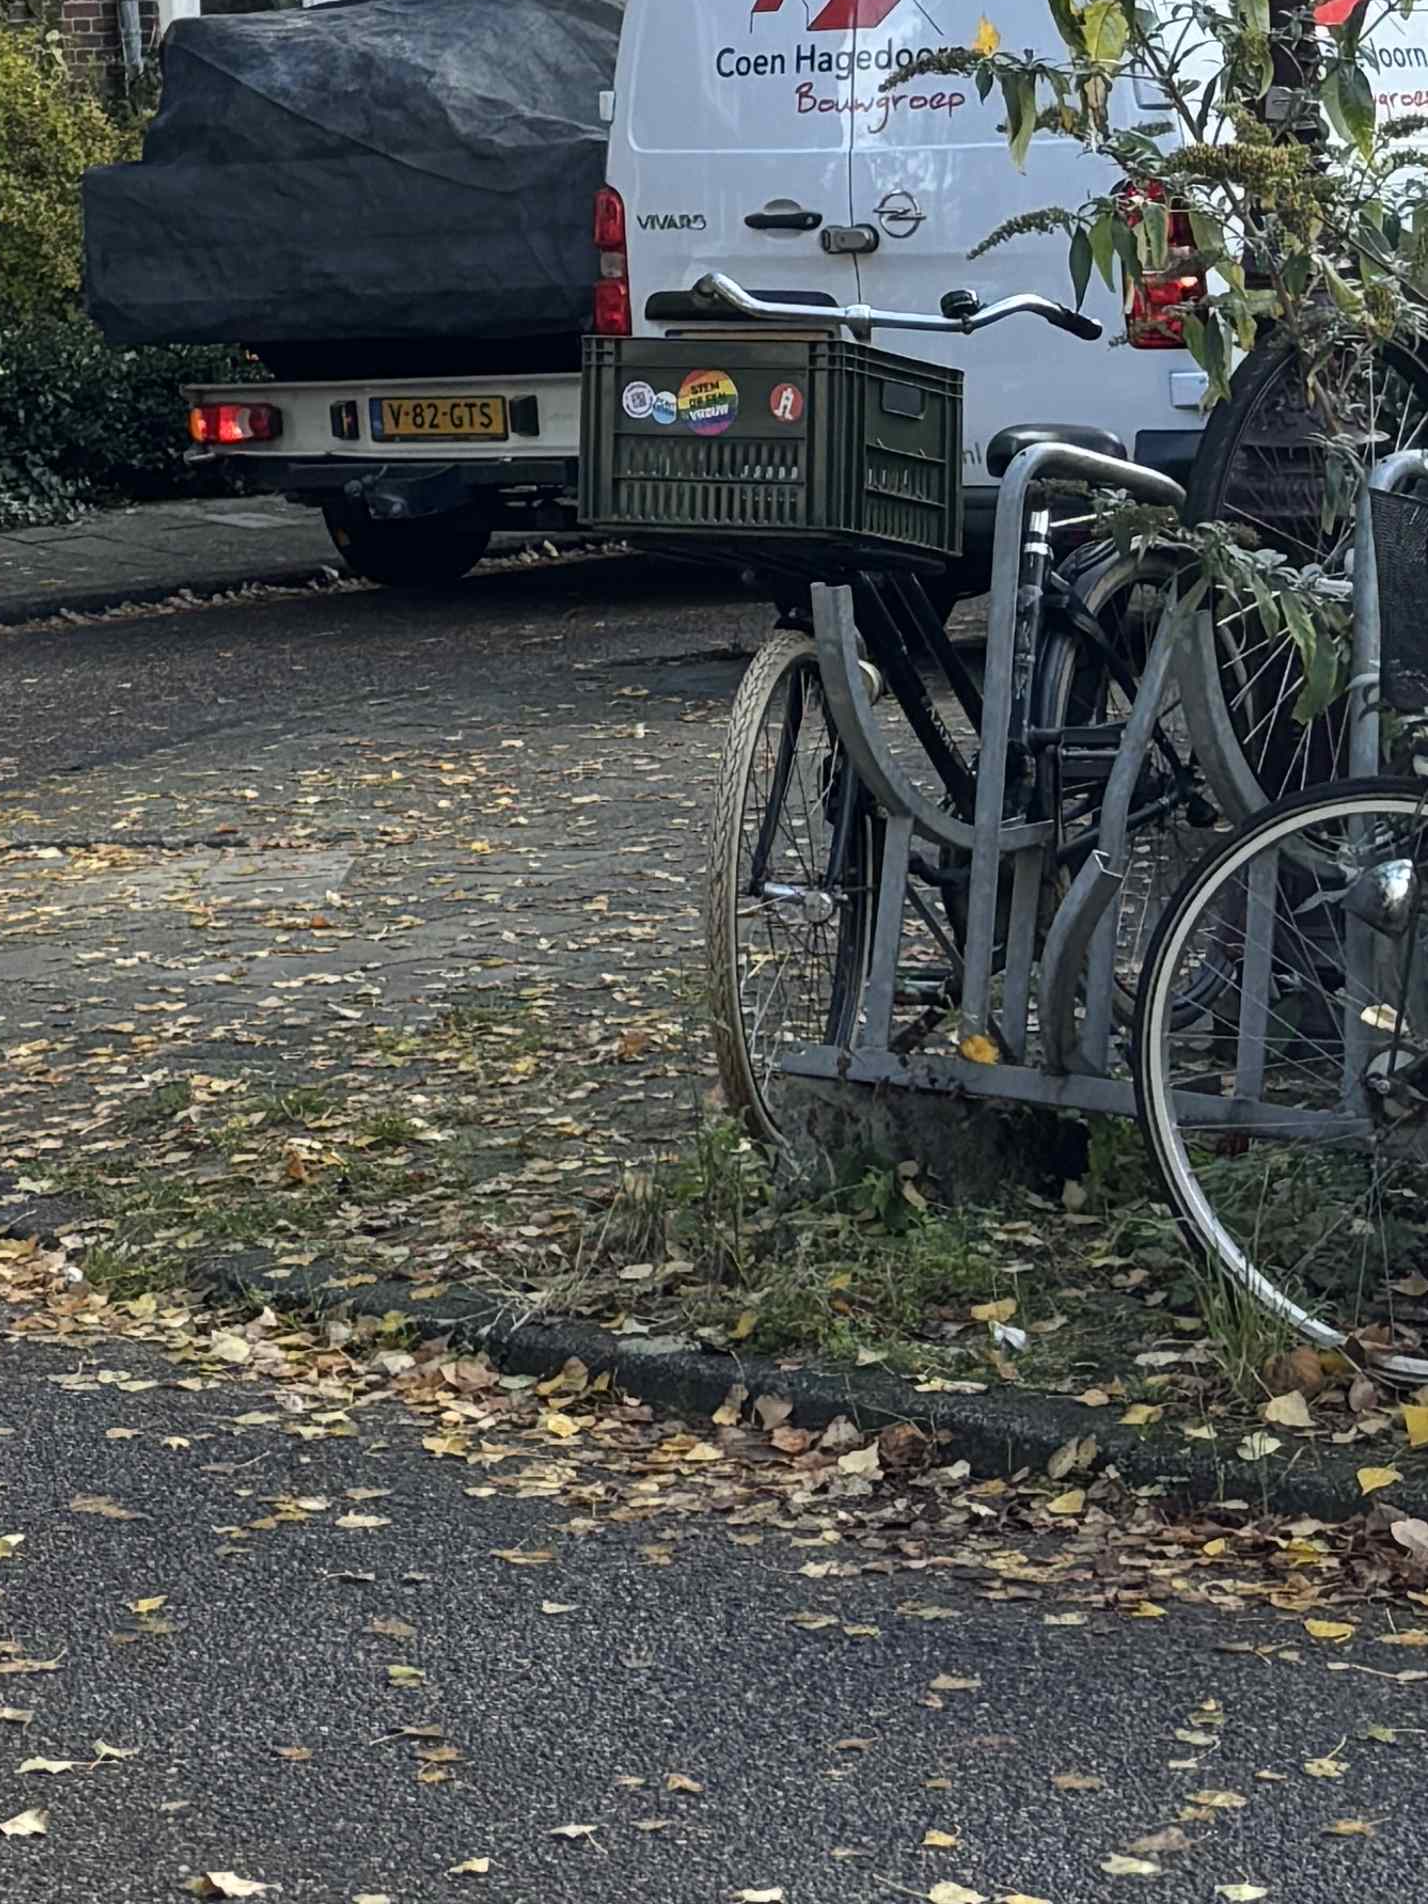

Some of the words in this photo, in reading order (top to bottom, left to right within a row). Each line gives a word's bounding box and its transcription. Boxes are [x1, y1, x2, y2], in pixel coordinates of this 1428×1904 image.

[716, 48, 786, 77] Coen
[795, 82, 965, 133] Bouwgroep
[387, 402, 493, 429] V-82-GTS
[689, 405, 729, 421] VROUW
